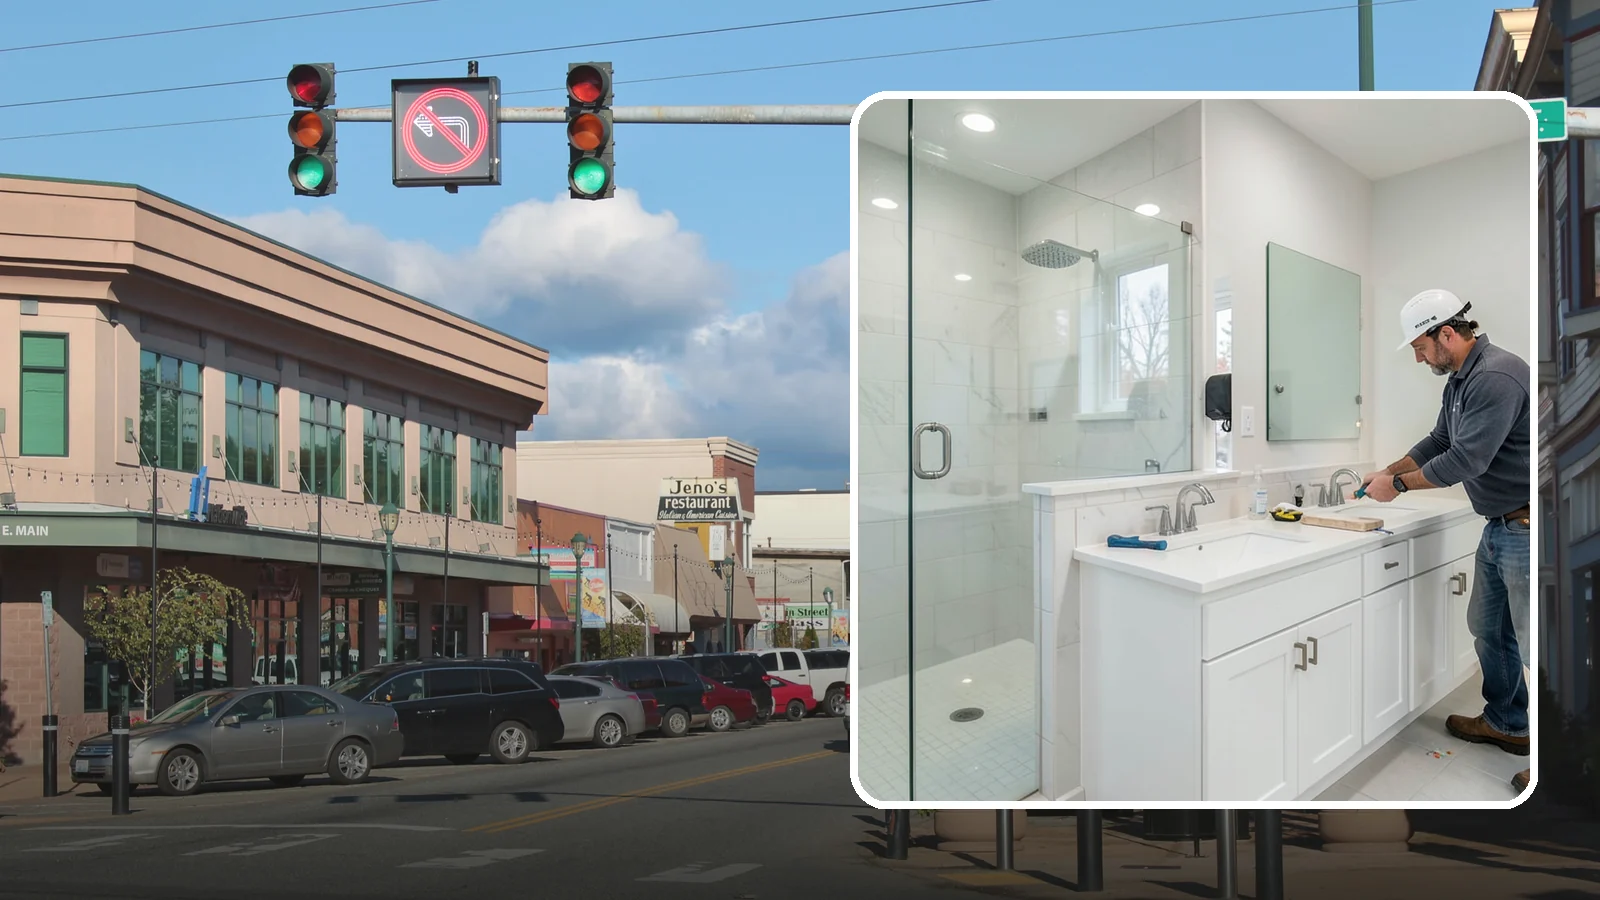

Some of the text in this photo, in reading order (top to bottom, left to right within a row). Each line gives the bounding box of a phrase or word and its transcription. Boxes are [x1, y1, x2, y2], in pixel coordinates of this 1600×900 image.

[669, 479, 728, 495] Jeno's
[665, 496, 731, 509] restaurant
[658, 509, 682, 520] Italian
[685, 509, 714, 519] American
[714, 509, 737, 519] Cuisine
[2, 525, 49, 536] E. MAIN
[797, 607, 828, 616] Street
